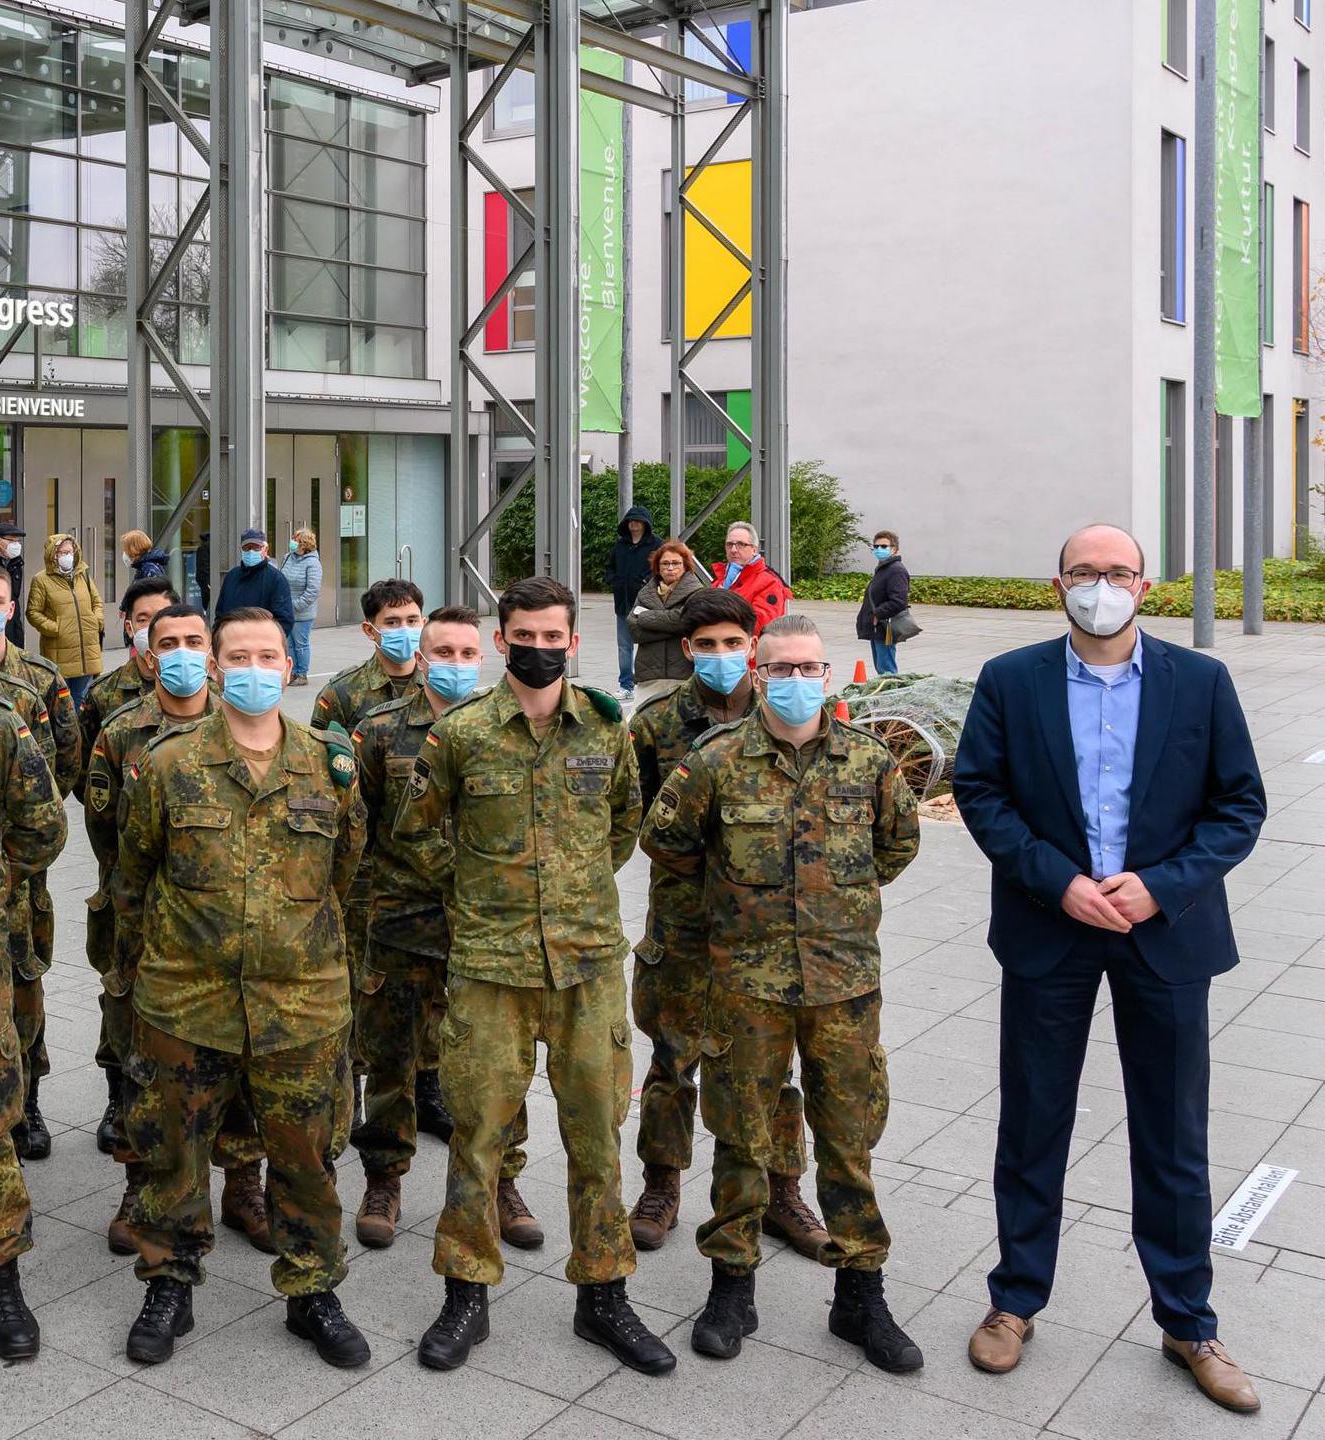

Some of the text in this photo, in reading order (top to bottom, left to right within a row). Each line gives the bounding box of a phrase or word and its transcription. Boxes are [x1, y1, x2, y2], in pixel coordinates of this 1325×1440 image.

[1227, 0, 1239, 150] Kongre
[601, 138, 616, 310] Bienvenue.
[1240, 140, 1253, 265] Kultur.
[1212, 1166, 1289, 1246] Bitte Abstand halten!
